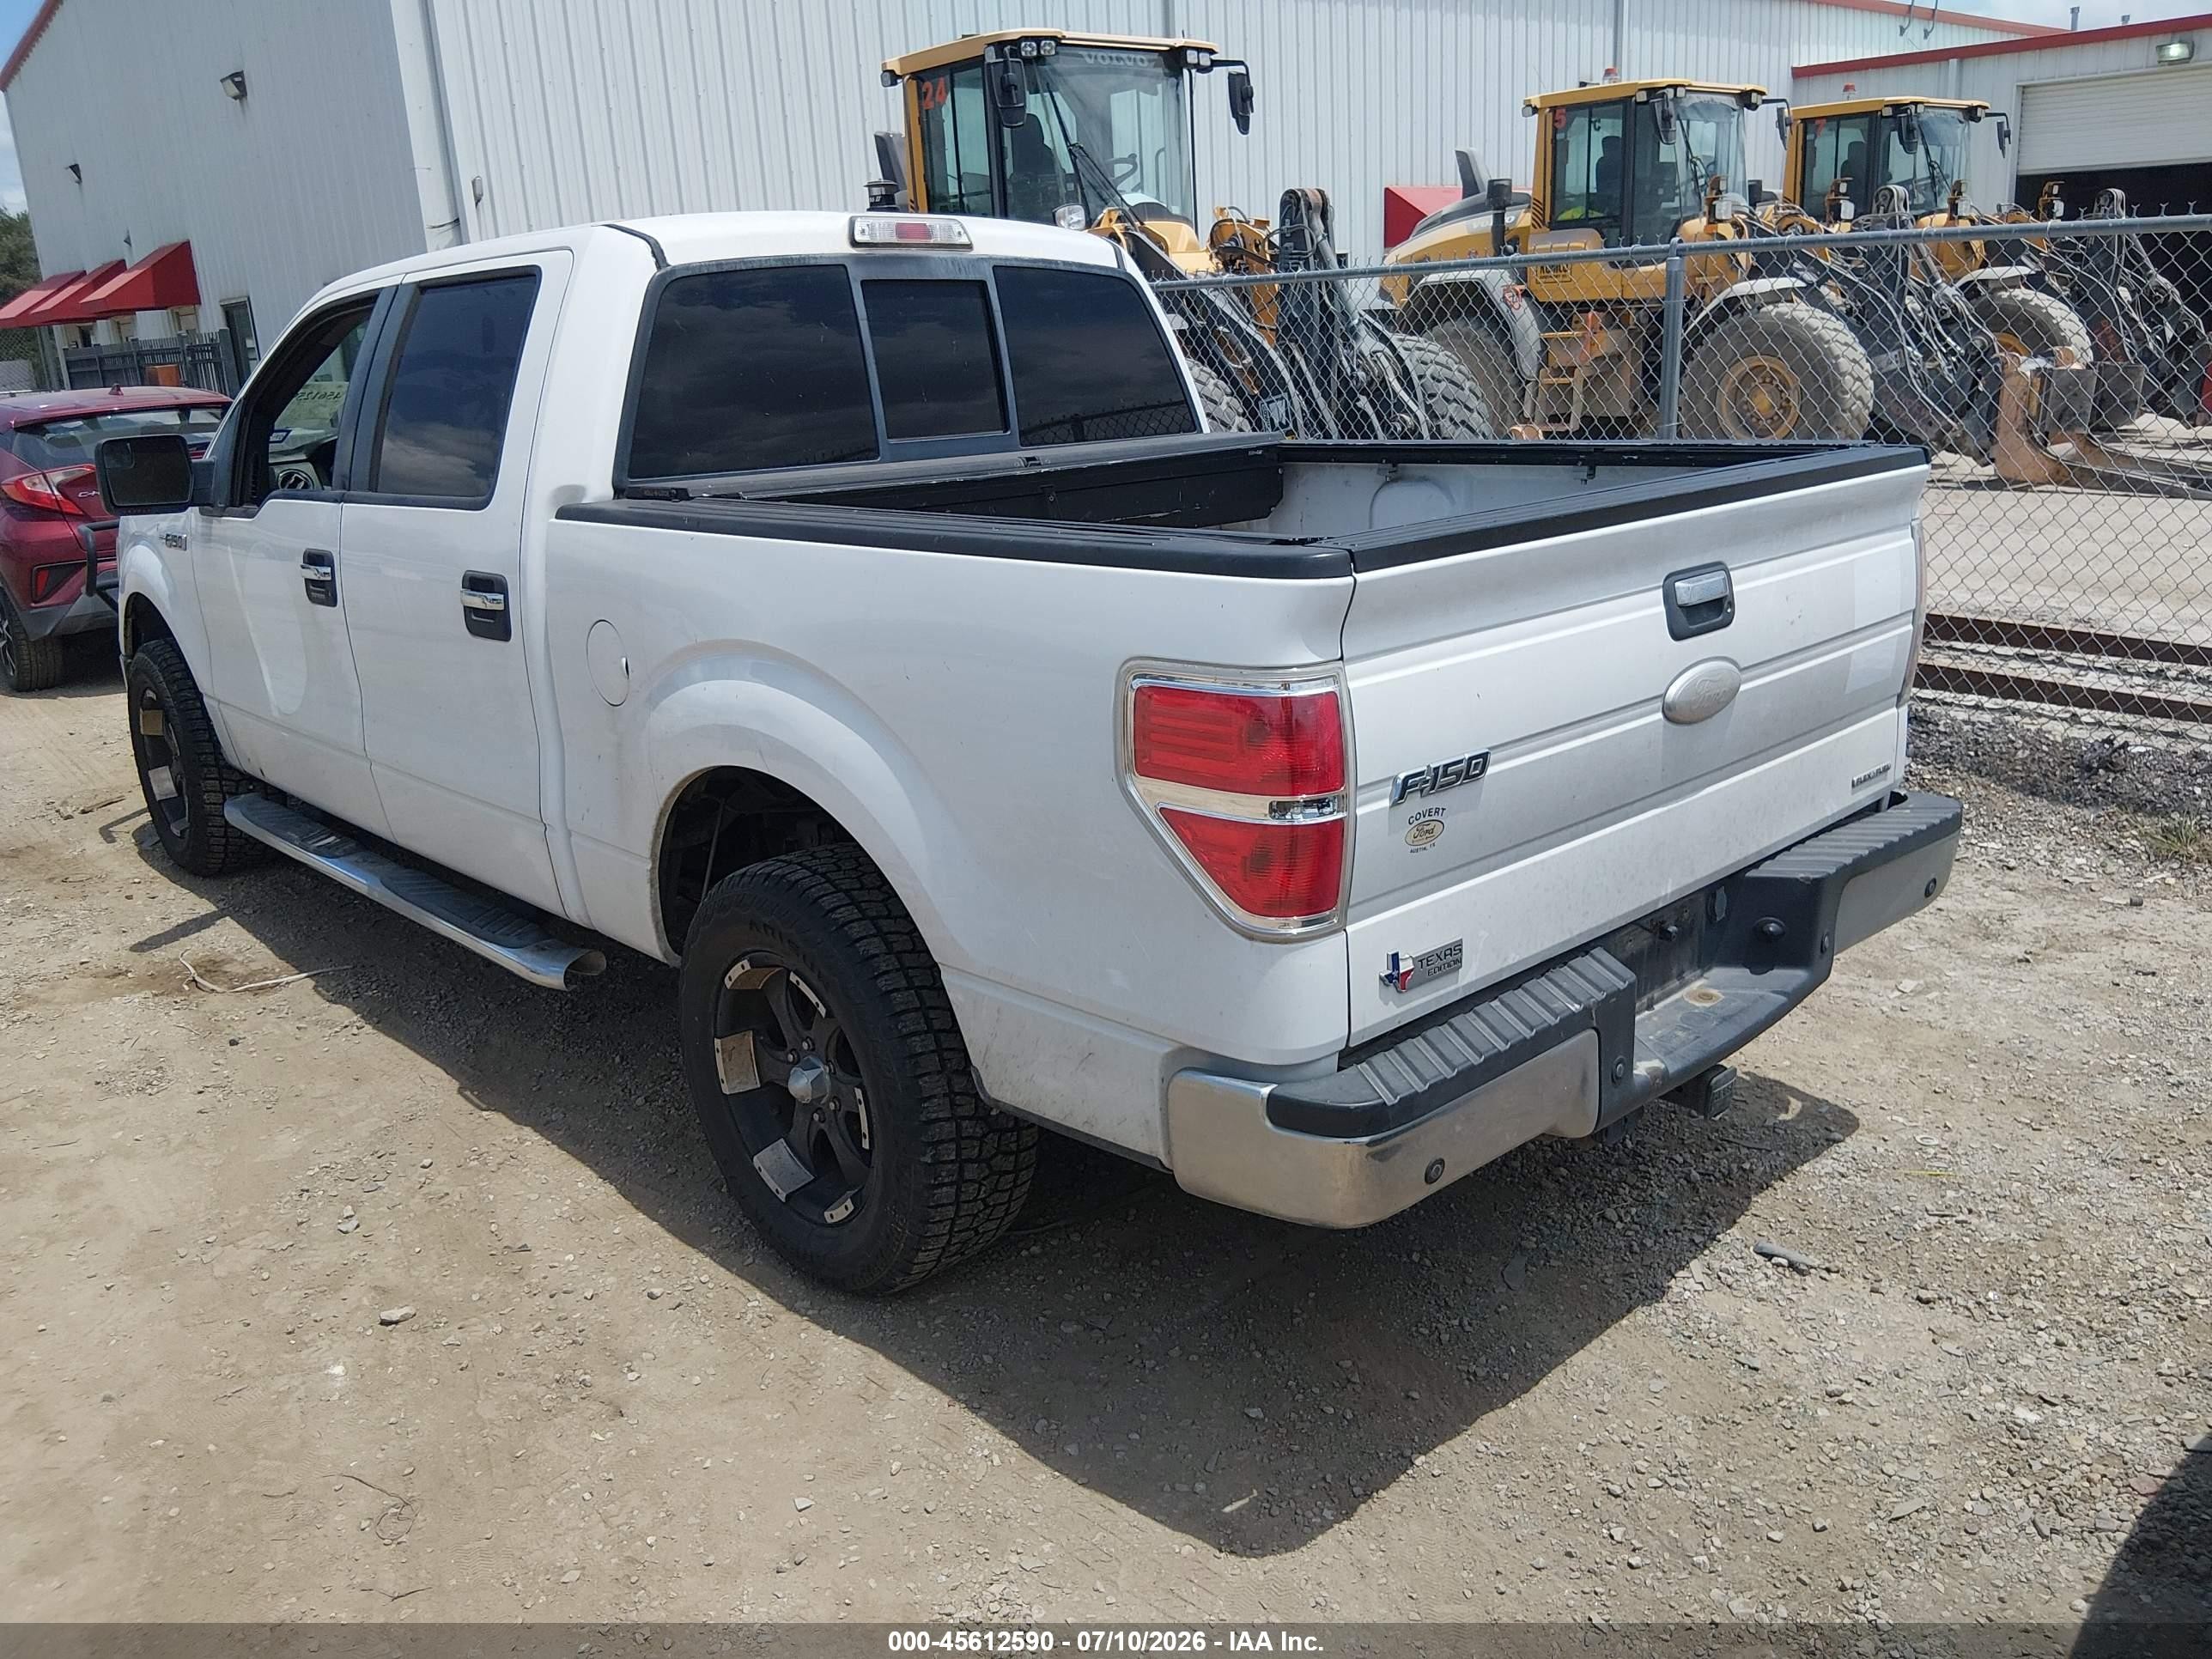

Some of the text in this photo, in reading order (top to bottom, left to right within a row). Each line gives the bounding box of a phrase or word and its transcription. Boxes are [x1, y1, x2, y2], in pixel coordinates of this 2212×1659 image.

[1079, 52, 1149, 68] VOLVO
[921, 76, 948, 110] 24
[1553, 108, 1567, 129] 5
[1408, 807, 1447, 825] COVERT
[1413, 822, 1437, 840] Ford
[1418, 943, 1462, 970] TEXAS
[1427, 957, 1462, 976] EDITION
